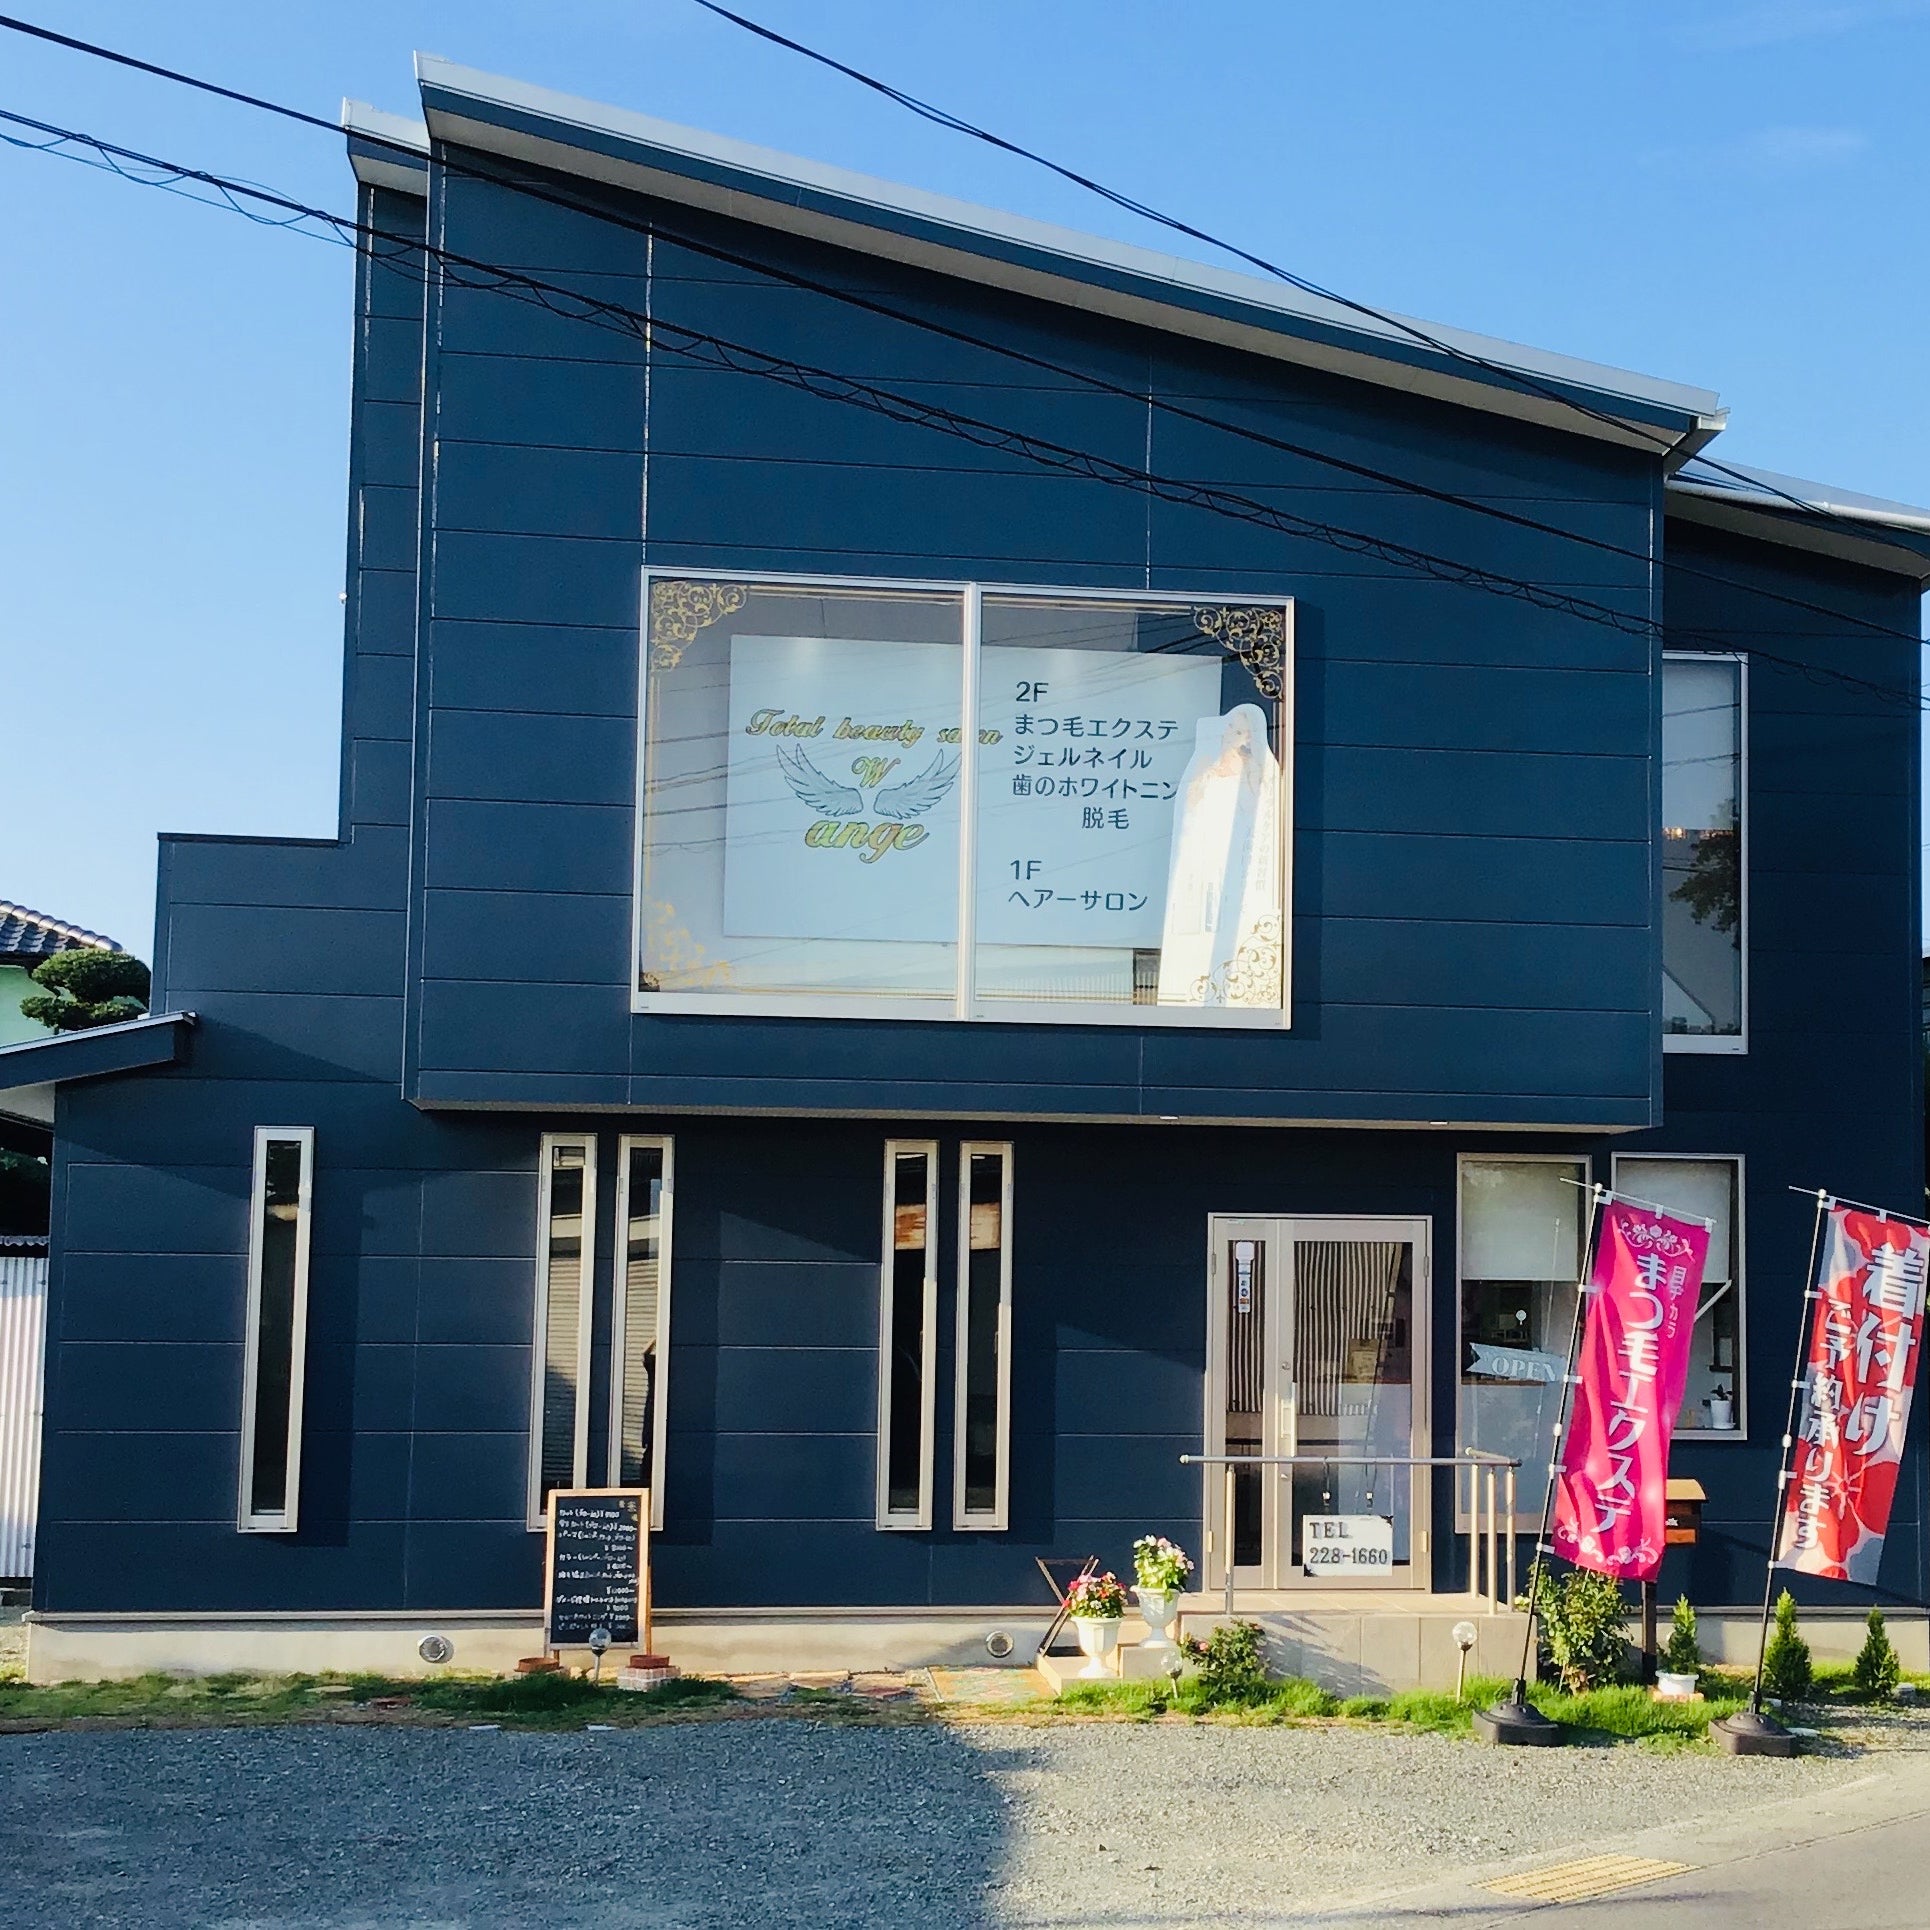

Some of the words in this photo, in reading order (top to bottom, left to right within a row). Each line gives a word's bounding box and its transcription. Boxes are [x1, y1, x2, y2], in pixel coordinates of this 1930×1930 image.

[1015, 681, 1049, 702] 2F
[745, 708, 826, 738] Total
[832, 717, 925, 748] beauty
[936, 727, 1003, 745] saon
[1014, 714, 1179, 741] まつ毛エクステ
[1013, 744, 1153, 770] ジェルネイル
[1081, 806, 1130, 830] 脱毛
[804, 820, 930, 864] ange
[1010, 859, 1043, 881] 1F
[1008, 888, 1149, 911] ヘアーサロン
[1845, 1241, 1925, 1456] 着付け
[1492, 1356, 1558, 1383] OPEN
[1589, 1252, 1669, 1534] まつ毛エクステ
[1794, 1298, 1853, 1550] ご予約承ります
[1309, 1521, 1350, 1539] TEL
[1309, 1546, 1388, 1565] 228-1660
